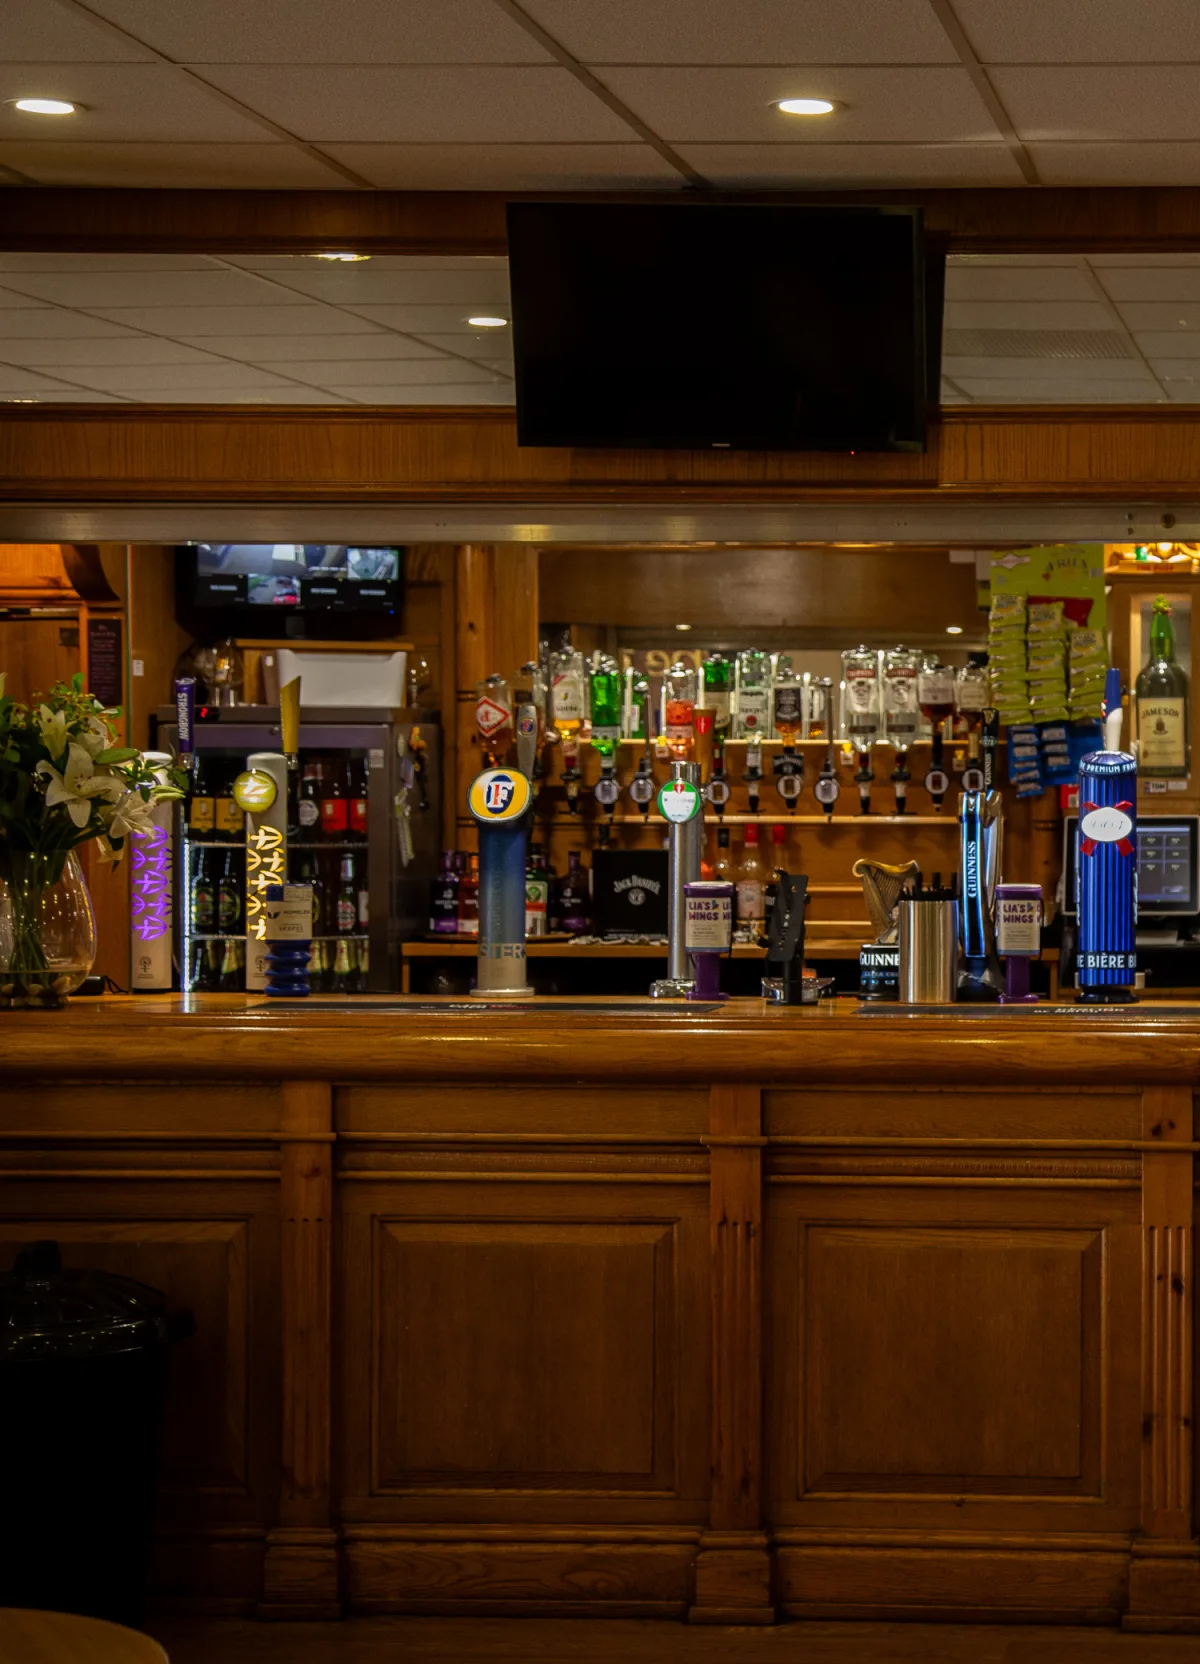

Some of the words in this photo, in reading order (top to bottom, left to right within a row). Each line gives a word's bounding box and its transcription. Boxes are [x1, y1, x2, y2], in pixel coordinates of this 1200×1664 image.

[177, 692, 190, 741] STRONGBOW
[1141, 707, 1180, 719] JAMESON
[1086, 763, 1121, 773] PREMIUM
[487, 781, 516, 808] F
[967, 840, 977, 898] GUINNESS
[613, 878, 632, 893] JACK
[688, 901, 711, 911] LIA'S
[1003, 903, 1027, 913] LIA'S
[688, 912, 719, 921] WINGS
[1003, 914, 1033, 924] WINGS
[1087, 952, 1125, 969] BIÈRE
